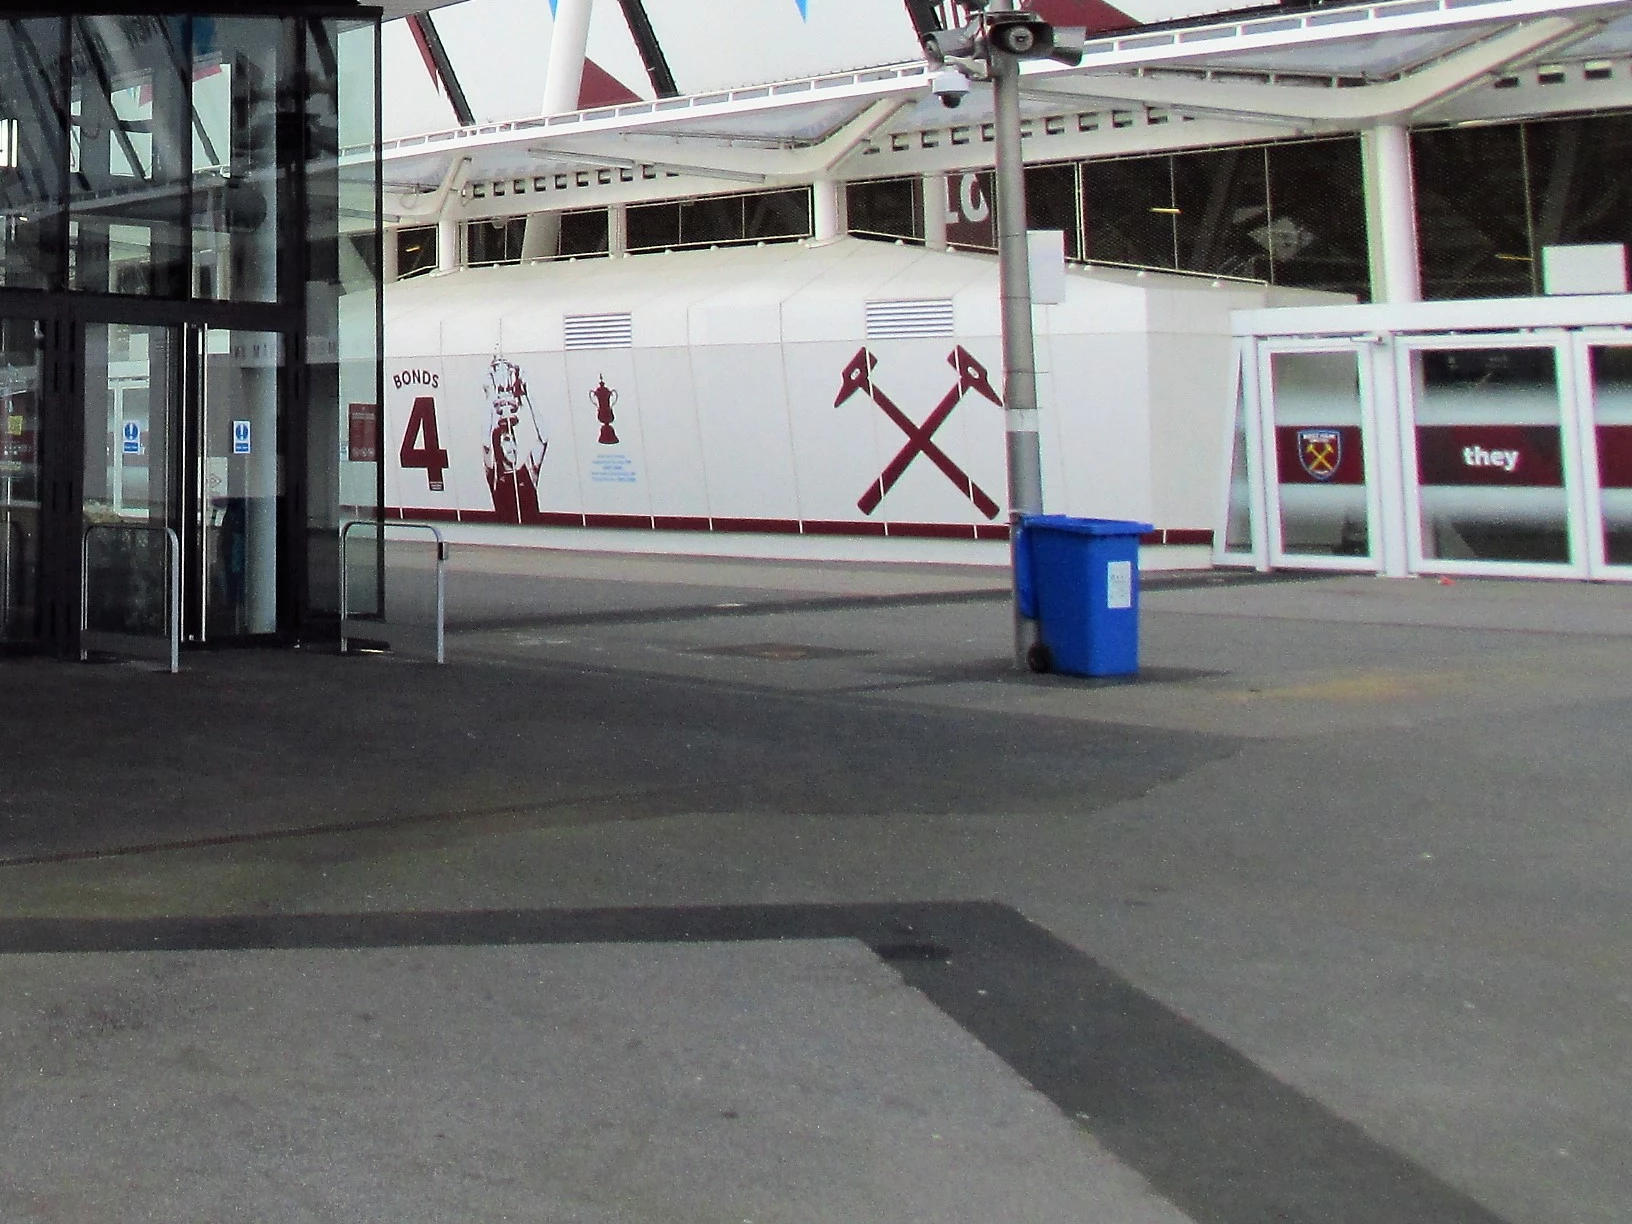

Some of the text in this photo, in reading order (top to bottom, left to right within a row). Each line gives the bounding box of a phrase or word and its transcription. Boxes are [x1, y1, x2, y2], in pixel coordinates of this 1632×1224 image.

[393, 369, 439, 389] BONDS
[399, 396, 449, 491] 4
[1462, 445, 1520, 472] they
